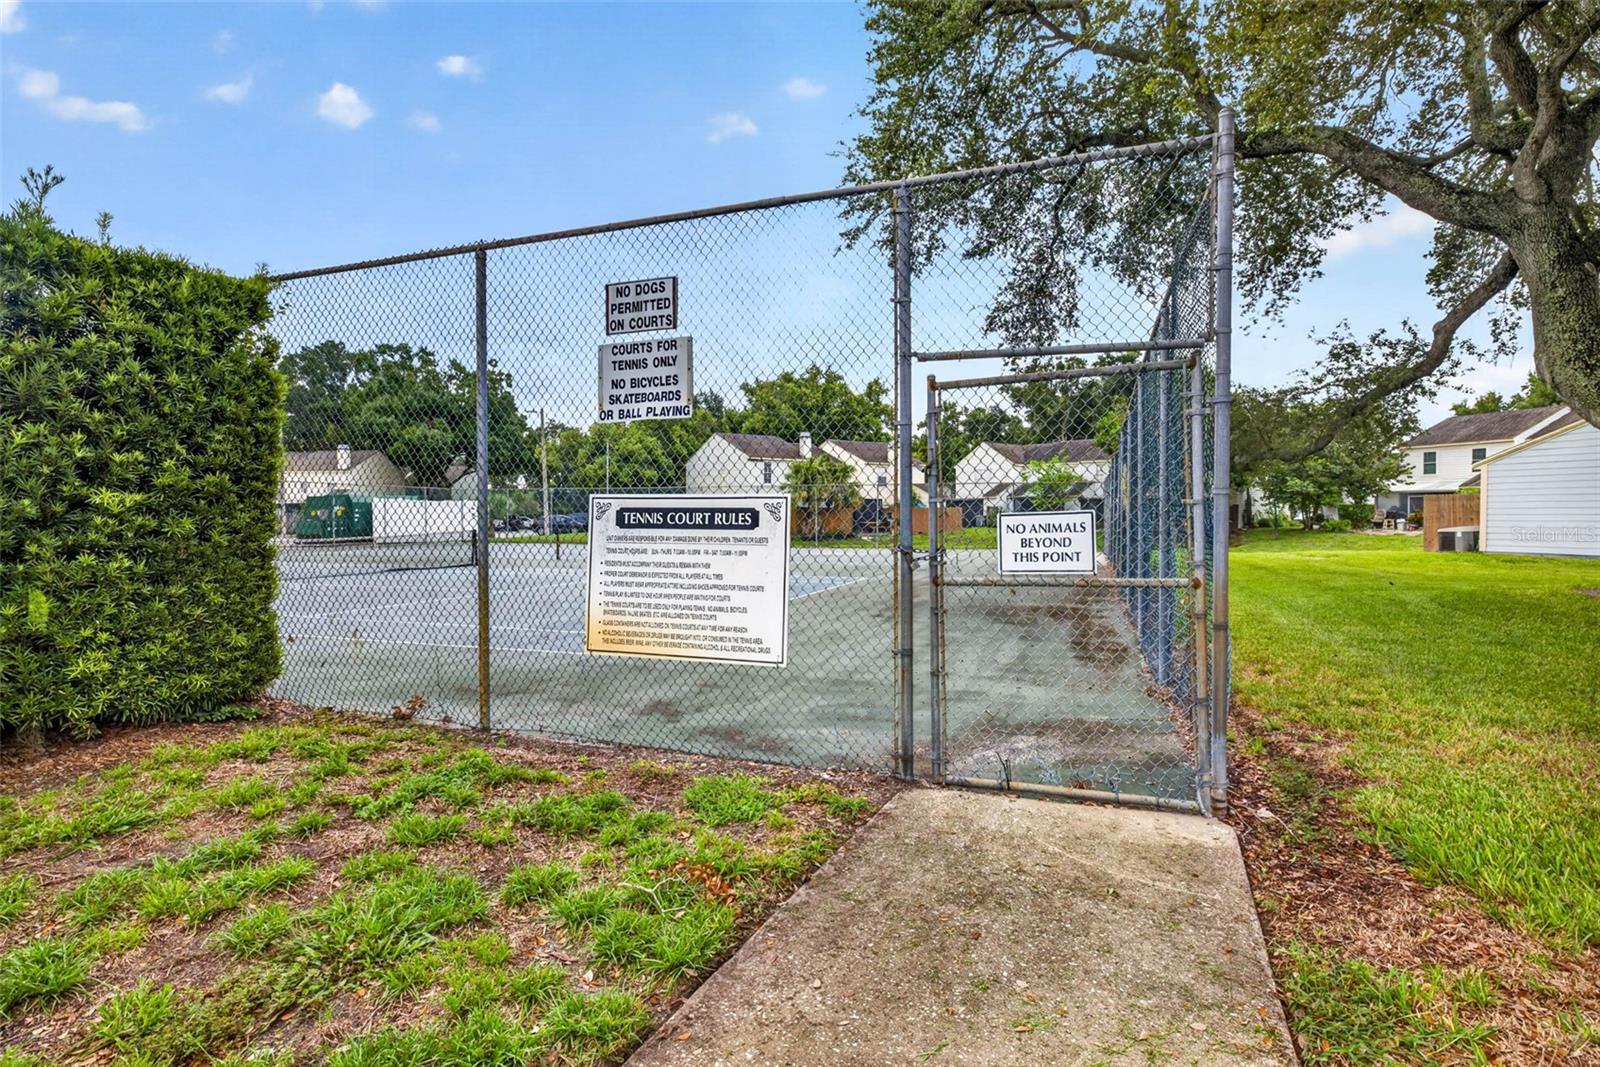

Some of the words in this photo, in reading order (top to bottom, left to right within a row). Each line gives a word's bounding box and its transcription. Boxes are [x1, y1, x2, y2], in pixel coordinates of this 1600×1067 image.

[616, 286, 630, 298] NO
[636, 281, 666, 296] DOGS
[611, 298, 670, 315] PERMITTED
[610, 319, 624, 331] ON
[629, 314, 672, 330] COURTS
[612, 342, 652, 356] COURTS
[658, 340, 678, 352] FOR
[612, 358, 648, 371] TENNIS
[653, 355, 678, 368] ONLY
[612, 379, 626, 390] NO
[630, 374, 678, 388] BICYCLES
[609, 390, 681, 405] SKATEBOARDS
[600, 410, 614, 420] OR
[618, 408, 642, 420] BALL
[646, 405, 690, 417] PLAYING
[623, 512, 663, 524] TENNIS
[667, 512, 711, 524] COURT
[714, 512, 752, 524] RULES
[1006, 523, 1026, 534] NO
[1029, 522, 1086, 534] ANIMALS
[1020, 537, 1072, 548] BEYOND
[1012, 552, 1039, 562] THIS
[1042, 552, 1082, 562] POINT
